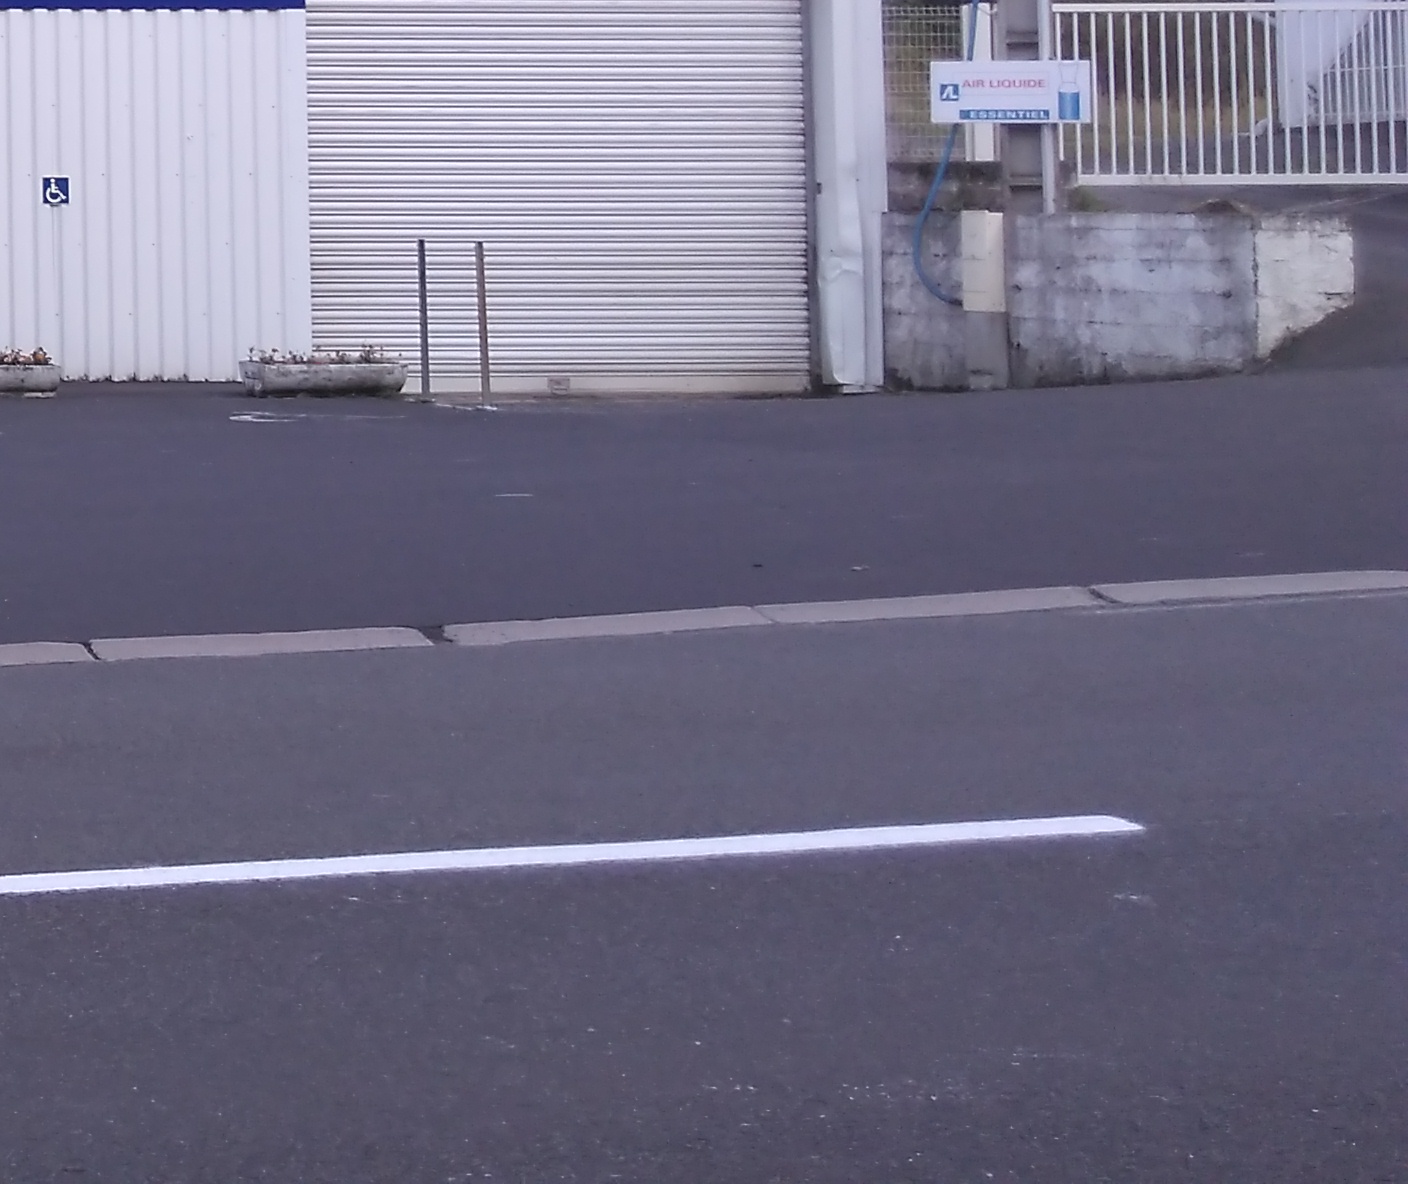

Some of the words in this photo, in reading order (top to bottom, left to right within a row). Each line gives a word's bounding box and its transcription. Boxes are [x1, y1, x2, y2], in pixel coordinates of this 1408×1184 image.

[962, 79, 985, 88] AIR
[989, 79, 1046, 88] LIQUIDE
[969, 110, 1049, 119] ESSENTIEL
